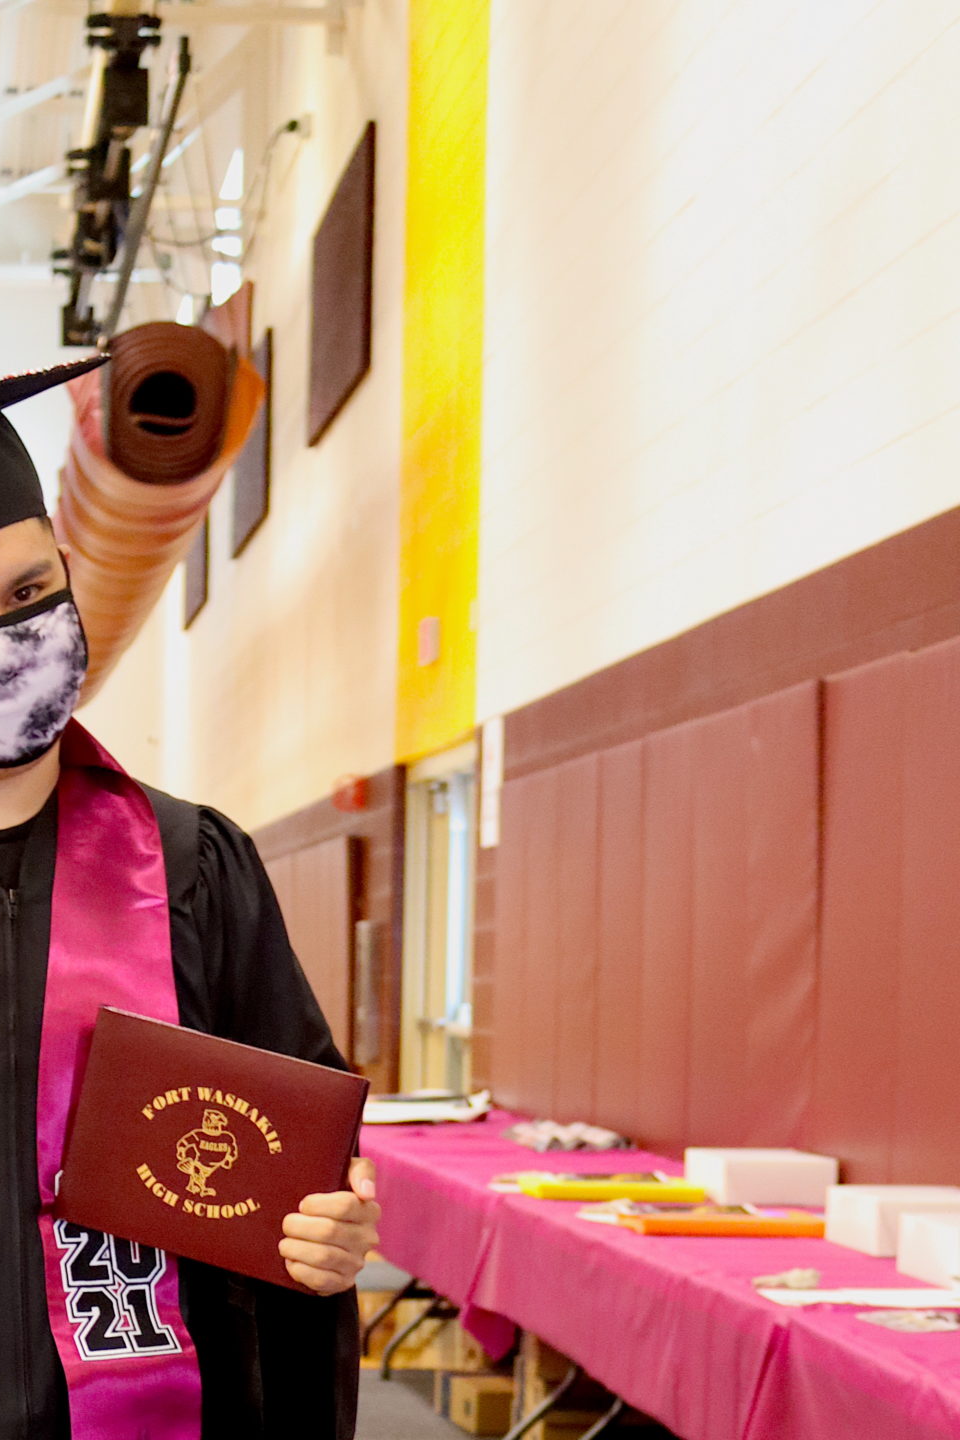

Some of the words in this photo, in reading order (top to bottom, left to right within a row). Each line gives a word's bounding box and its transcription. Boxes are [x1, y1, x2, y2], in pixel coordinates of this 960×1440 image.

[141, 1086, 192, 1121] FORT
[197, 1086, 283, 1155] WASHAKIE
[199, 1140, 228, 1153] EAGLES
[136, 1162, 180, 1208] HIGH
[182, 1198, 261, 1220] SCHOOL
[54, 1219, 166, 1287] 20
[66, 1283, 182, 1361] 21
